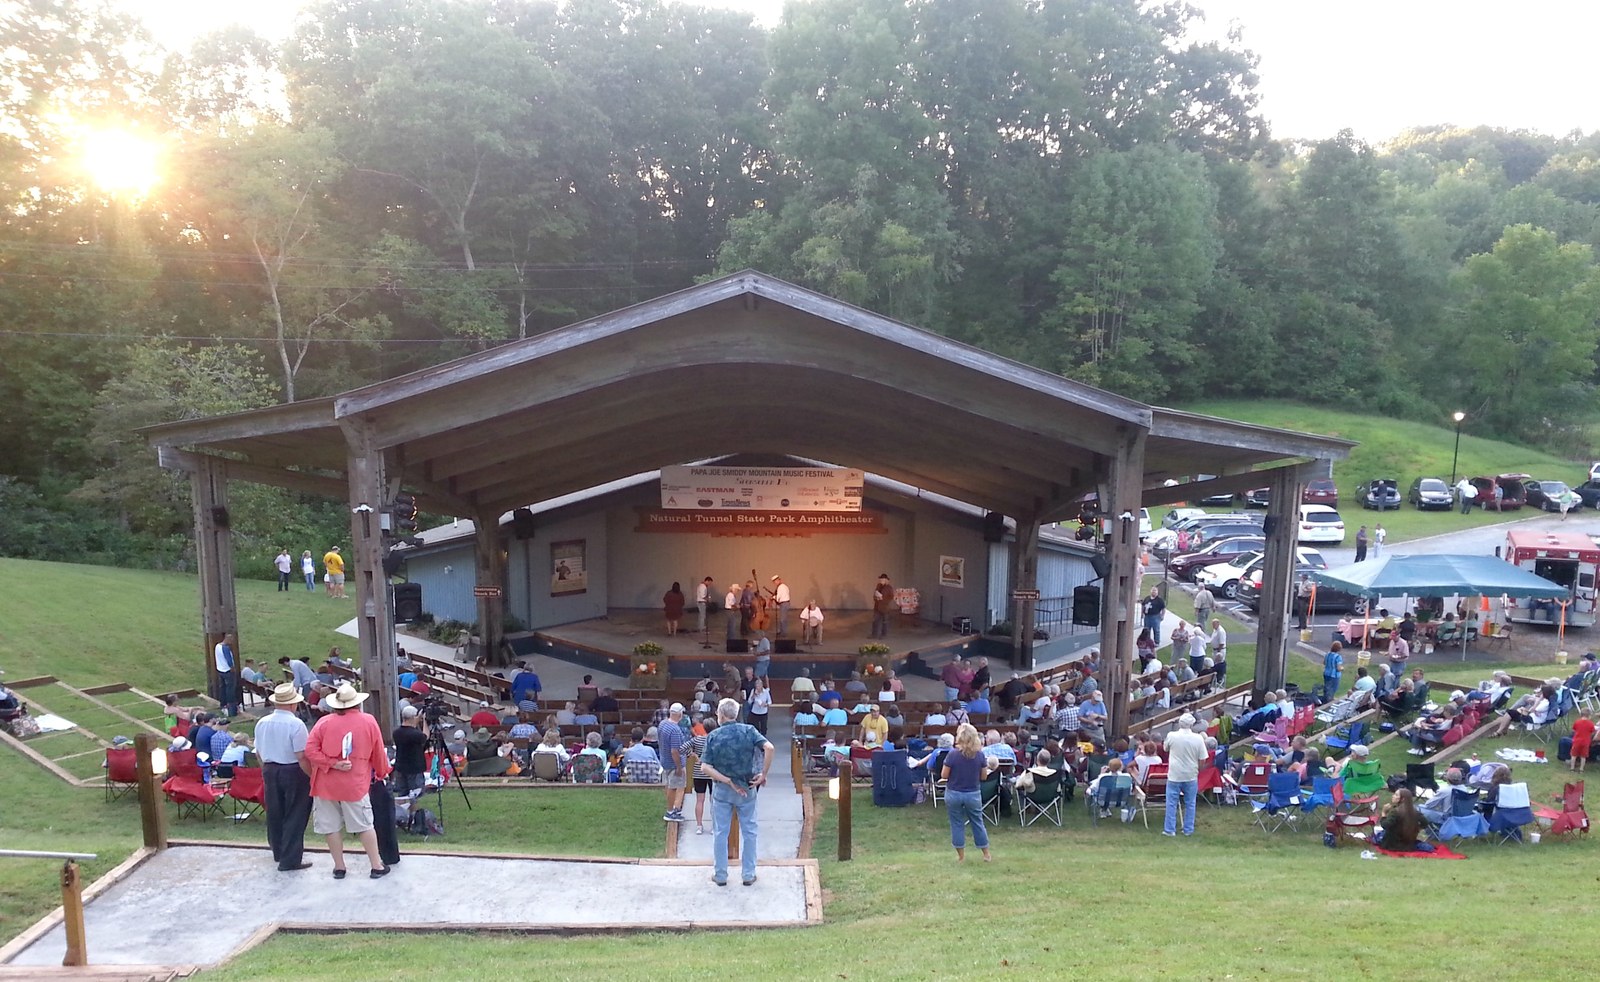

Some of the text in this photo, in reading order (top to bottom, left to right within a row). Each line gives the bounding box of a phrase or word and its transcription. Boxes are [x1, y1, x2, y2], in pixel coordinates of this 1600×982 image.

[690, 468, 708, 476] PAPA
[708, 468, 721, 477] JOE
[722, 469, 747, 477] SMIDDY
[783, 470, 804, 478] MUSIC
[805, 470, 835, 478] FESTIVAL
[650, 514, 873, 524] Natural Tunnel State Park Amphitheater
